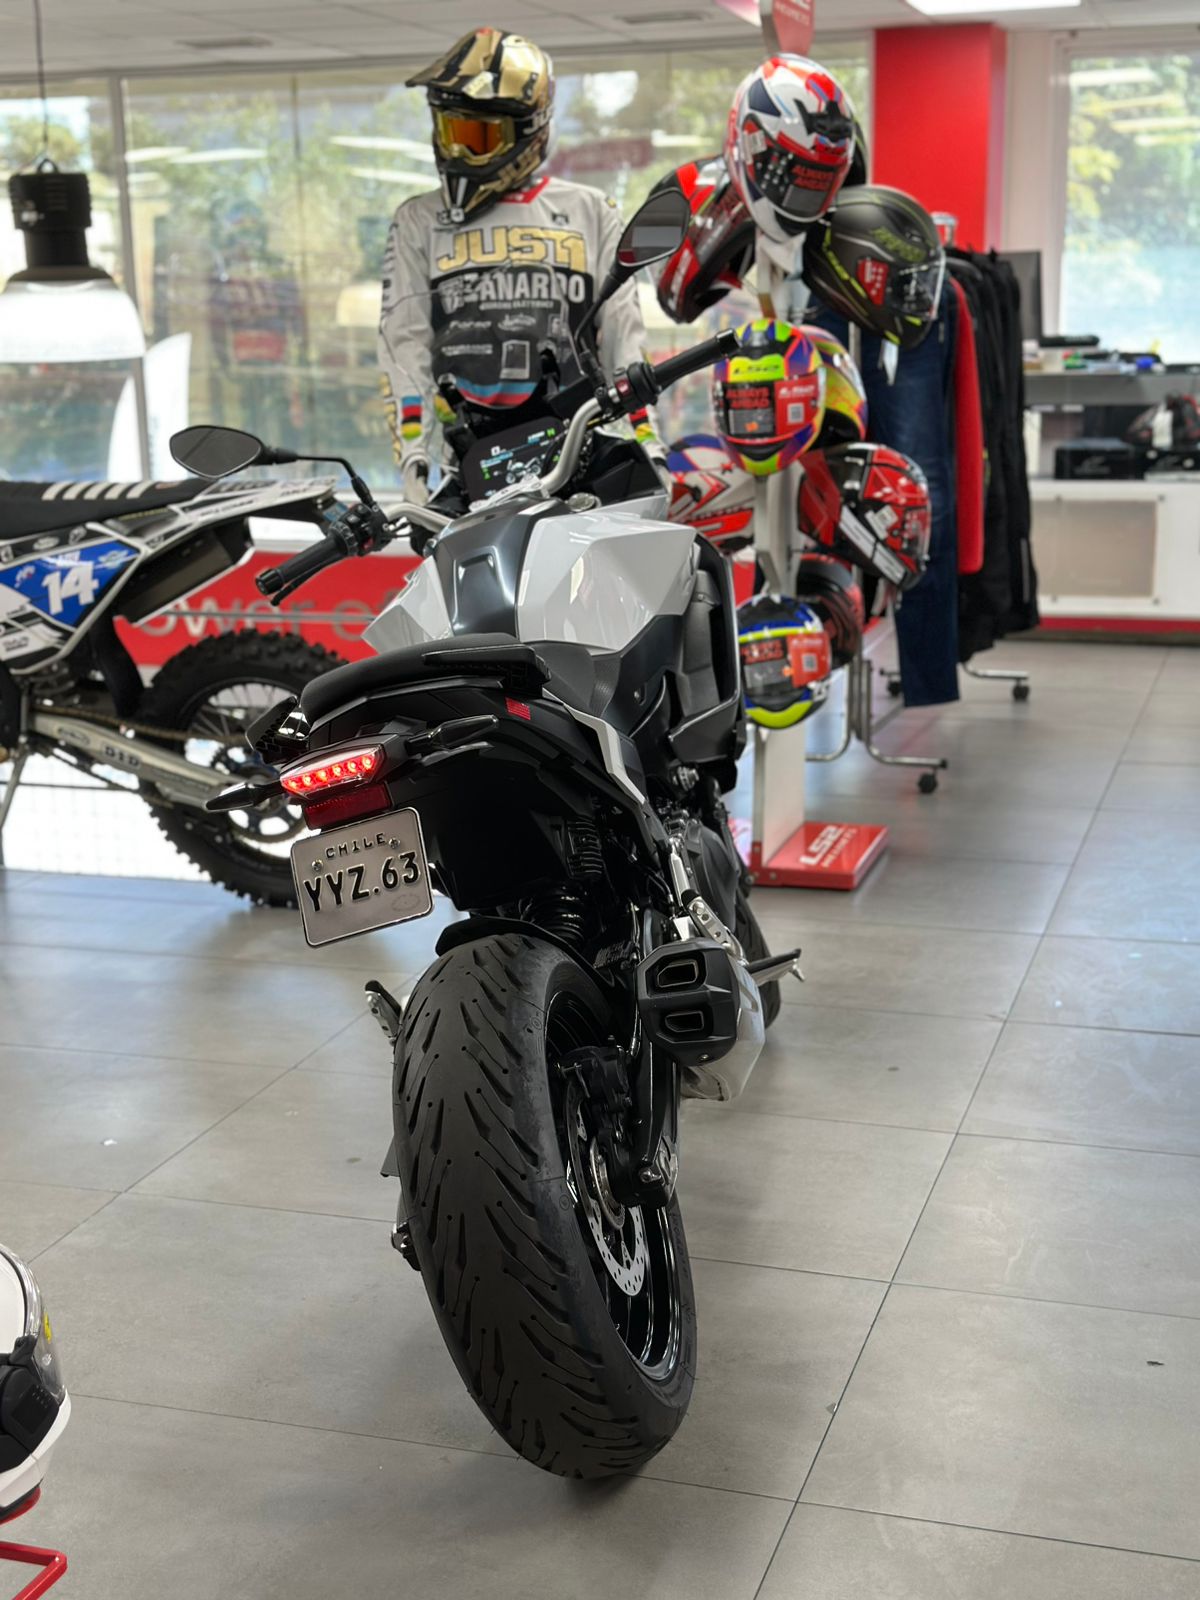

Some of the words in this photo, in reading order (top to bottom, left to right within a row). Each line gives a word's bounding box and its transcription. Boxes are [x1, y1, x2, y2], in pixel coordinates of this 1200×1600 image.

[436, 226, 586, 272] JUST1
[41, 561, 99, 616] 14
[325, 832, 387, 859] CHILE
[303, 851, 421, 912] YYZ.63
